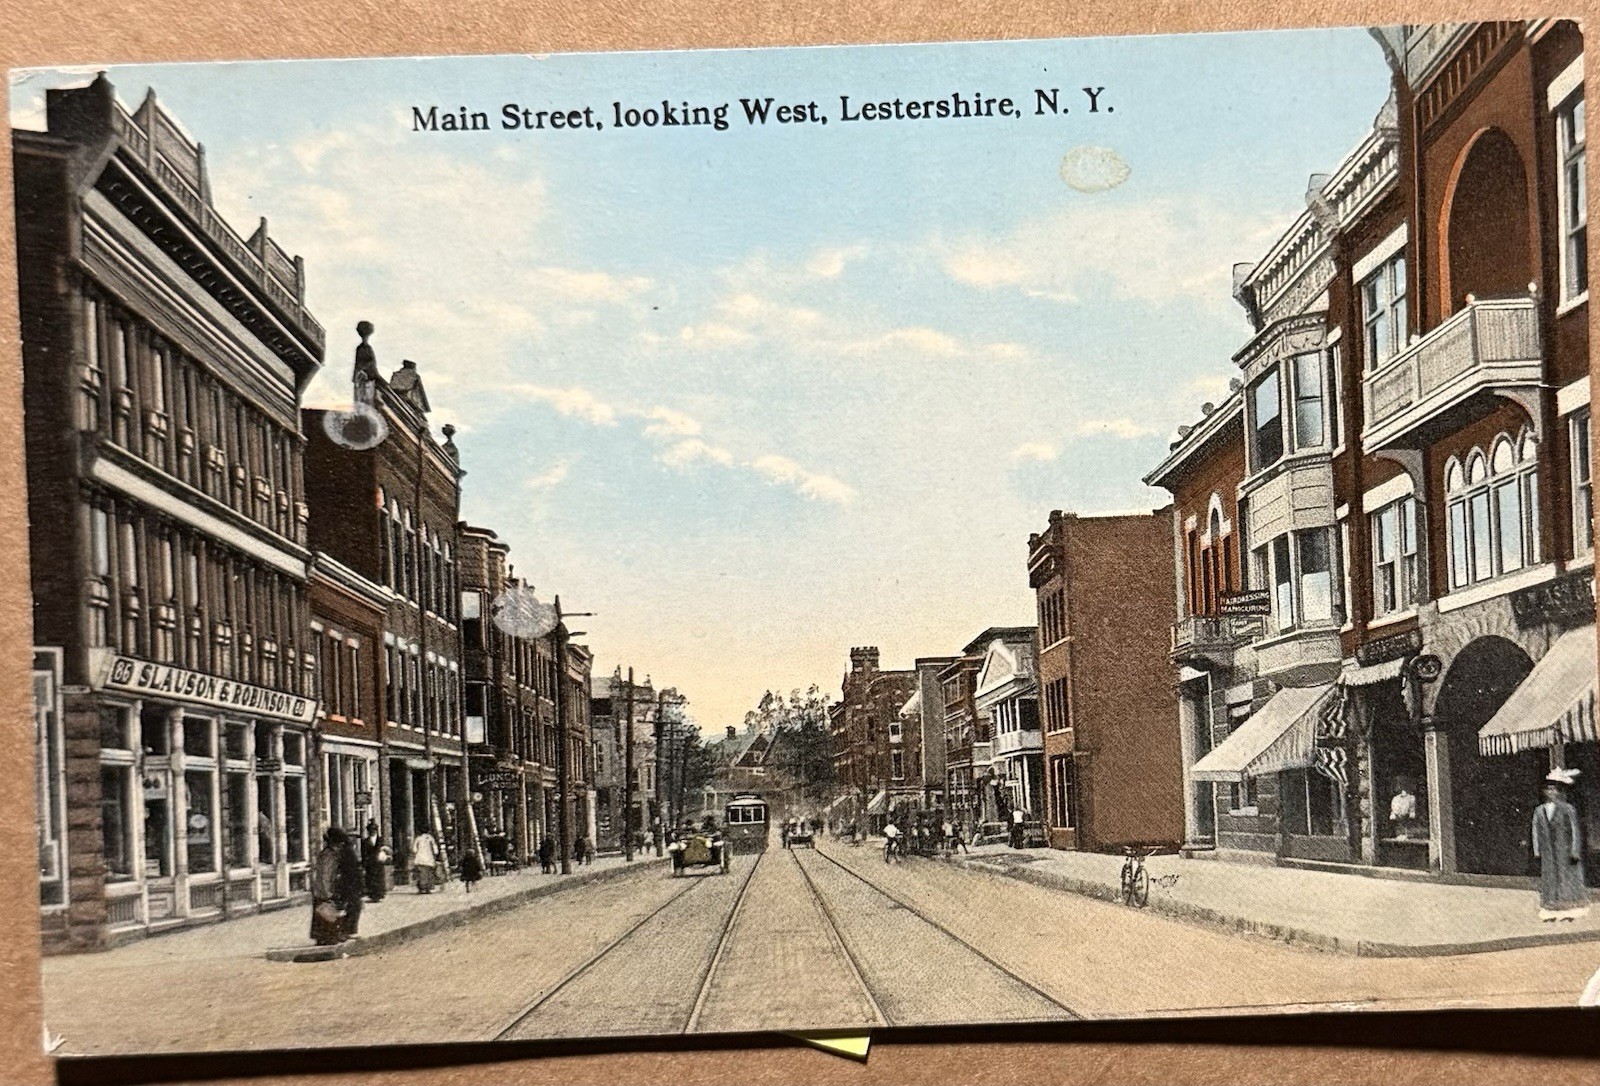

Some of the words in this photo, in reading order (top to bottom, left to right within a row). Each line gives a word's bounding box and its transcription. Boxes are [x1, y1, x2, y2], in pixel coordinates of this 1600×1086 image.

[412, 106, 490, 132] Main
[501, 103, 604, 131] Street,
[613, 100, 729, 131] looking
[739, 97, 828, 125] West,
[840, 92, 1021, 121] Lestershire,
[1035, 88, 1069, 115] N.
[1083, 87, 1115, 112] Y.
[138, 664, 215, 701] SLAUSON
[219, 682, 230, 701] &
[232, 684, 291, 713] ROBINSON
